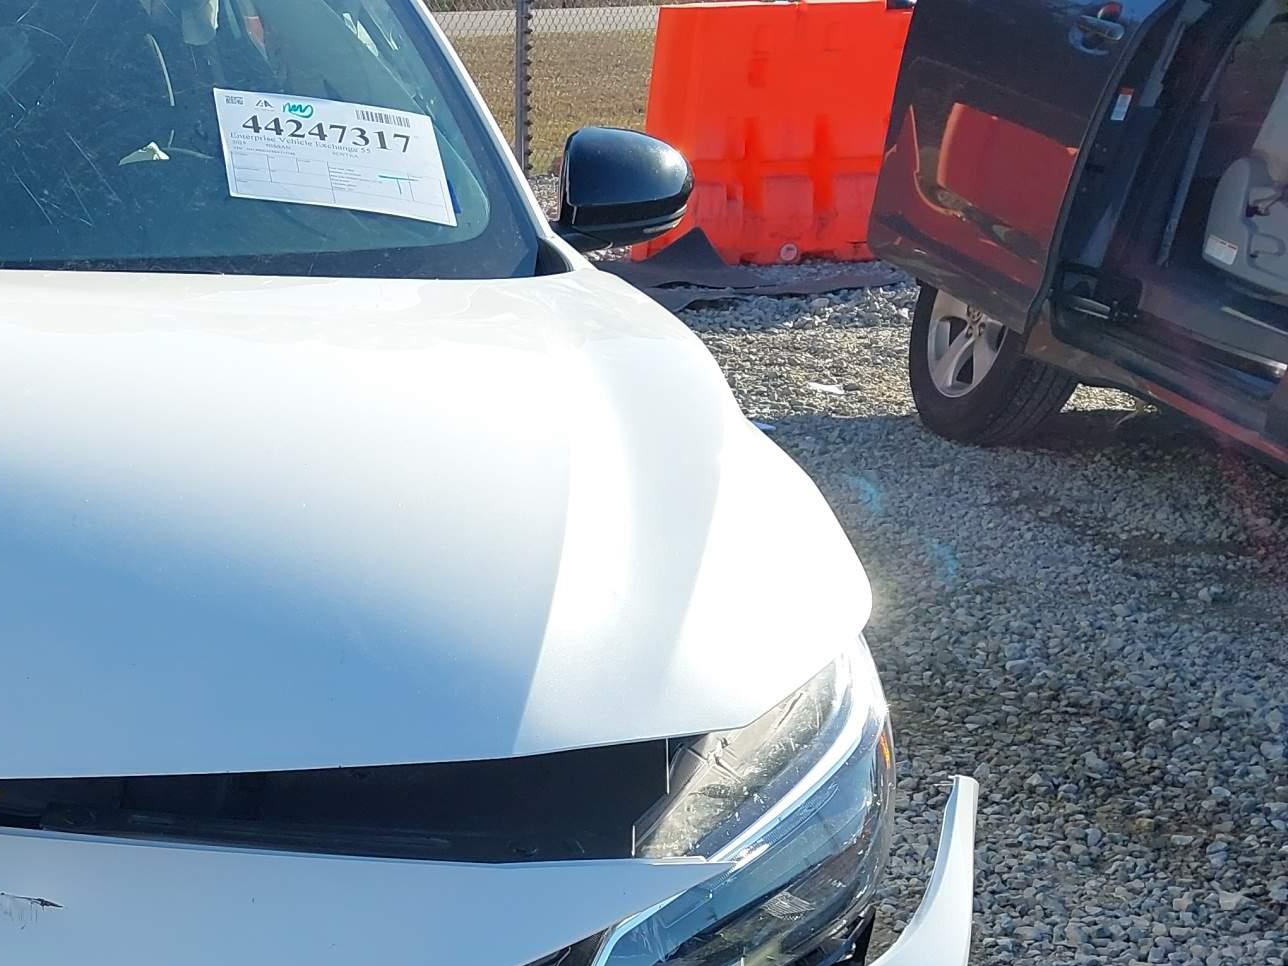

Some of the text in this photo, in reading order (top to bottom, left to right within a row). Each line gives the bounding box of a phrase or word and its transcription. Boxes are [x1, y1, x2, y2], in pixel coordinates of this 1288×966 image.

[230, 131, 277, 145] Enterprise
[278, 136, 313, 148] Vehicle
[315, 140, 358, 154] Exchange
[242, 114, 410, 153] 44247317
